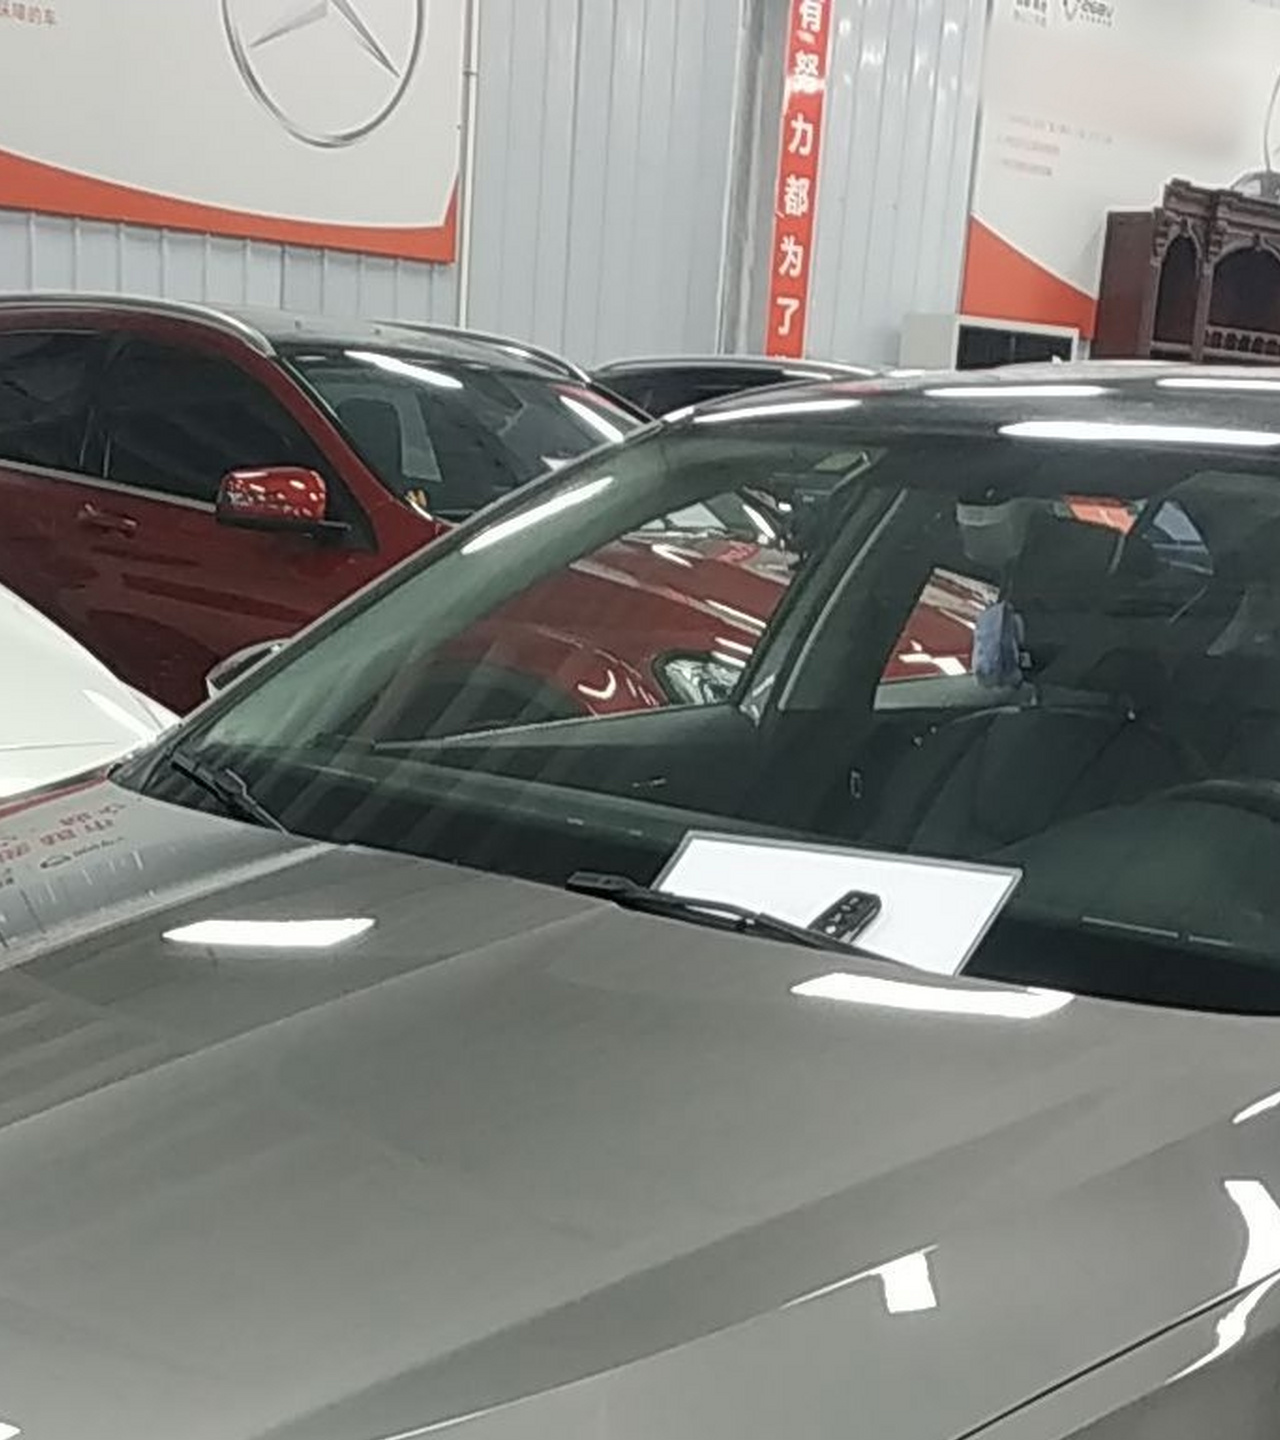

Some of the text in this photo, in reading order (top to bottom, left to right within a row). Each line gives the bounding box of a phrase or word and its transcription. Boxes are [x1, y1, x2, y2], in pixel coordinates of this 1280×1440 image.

[775, 0, 822, 358] 有努力都为了
